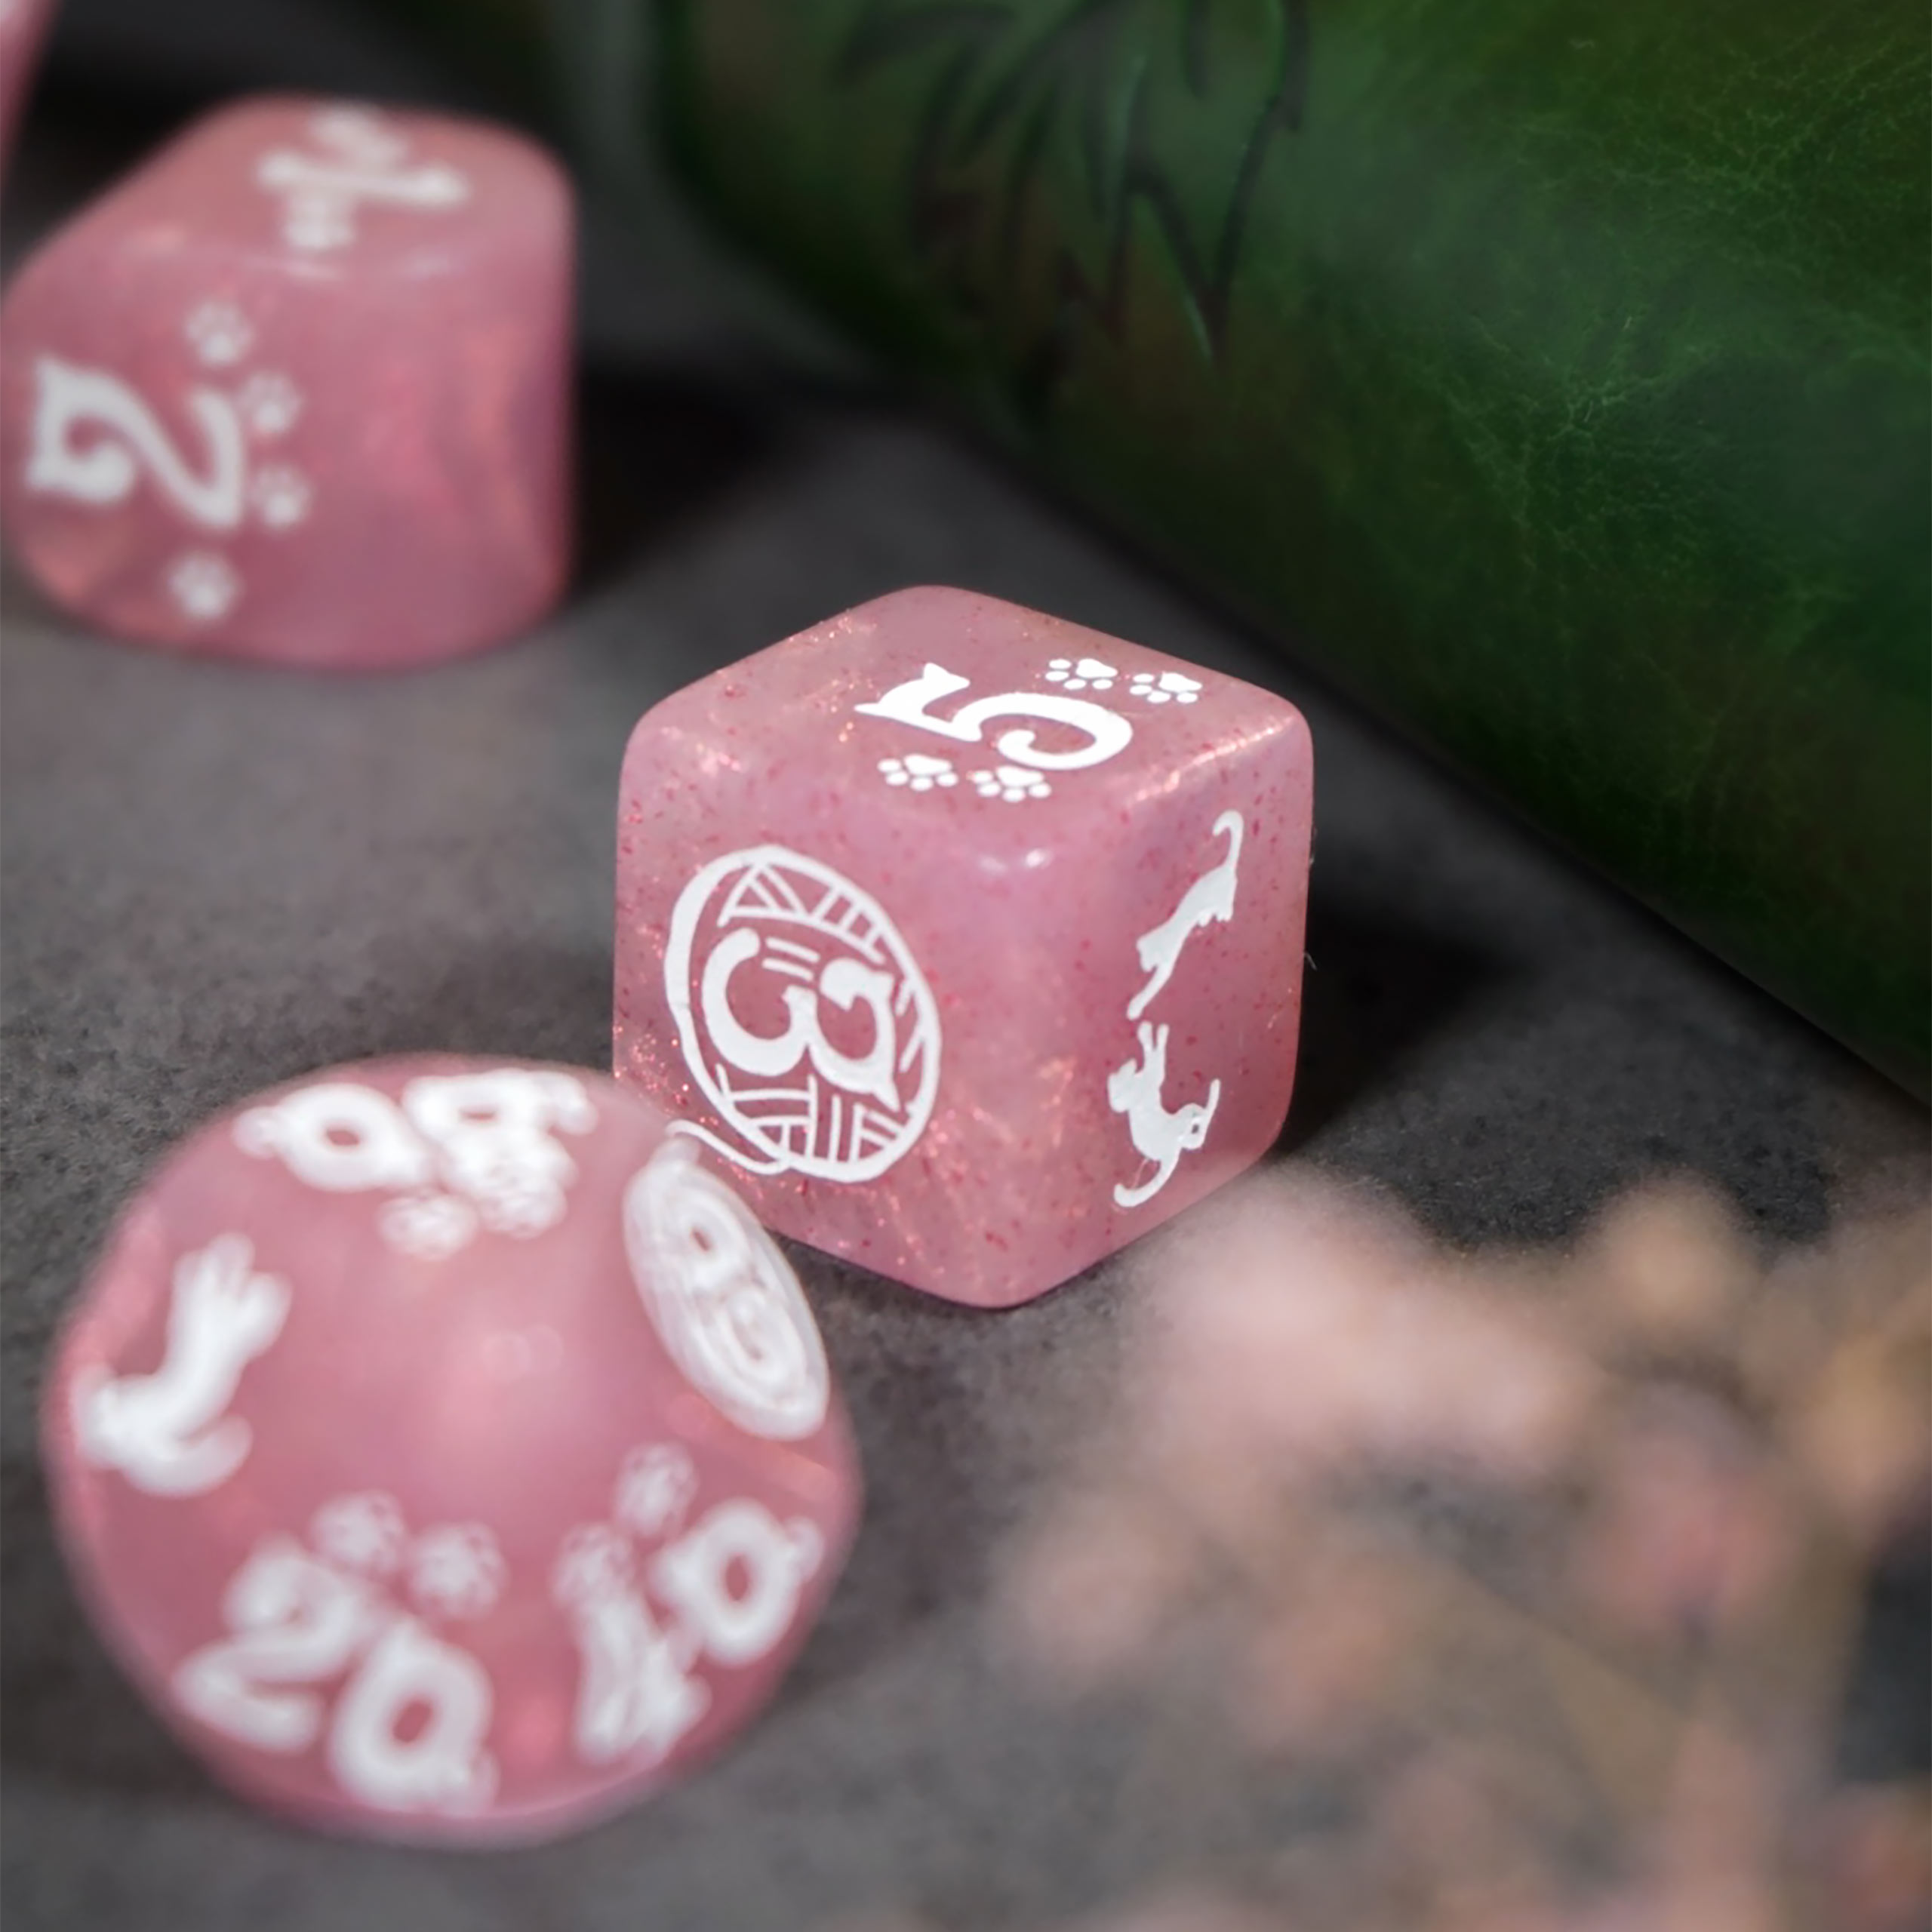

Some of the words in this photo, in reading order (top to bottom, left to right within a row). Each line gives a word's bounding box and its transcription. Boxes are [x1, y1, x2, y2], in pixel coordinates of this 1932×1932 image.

[26, 351, 249, 532] 2
[854, 662, 1133, 771] 5
[701, 928, 899, 1111] 3
[174, 1534, 498, 1817] 20
[572, 1495, 824, 1764] 40
